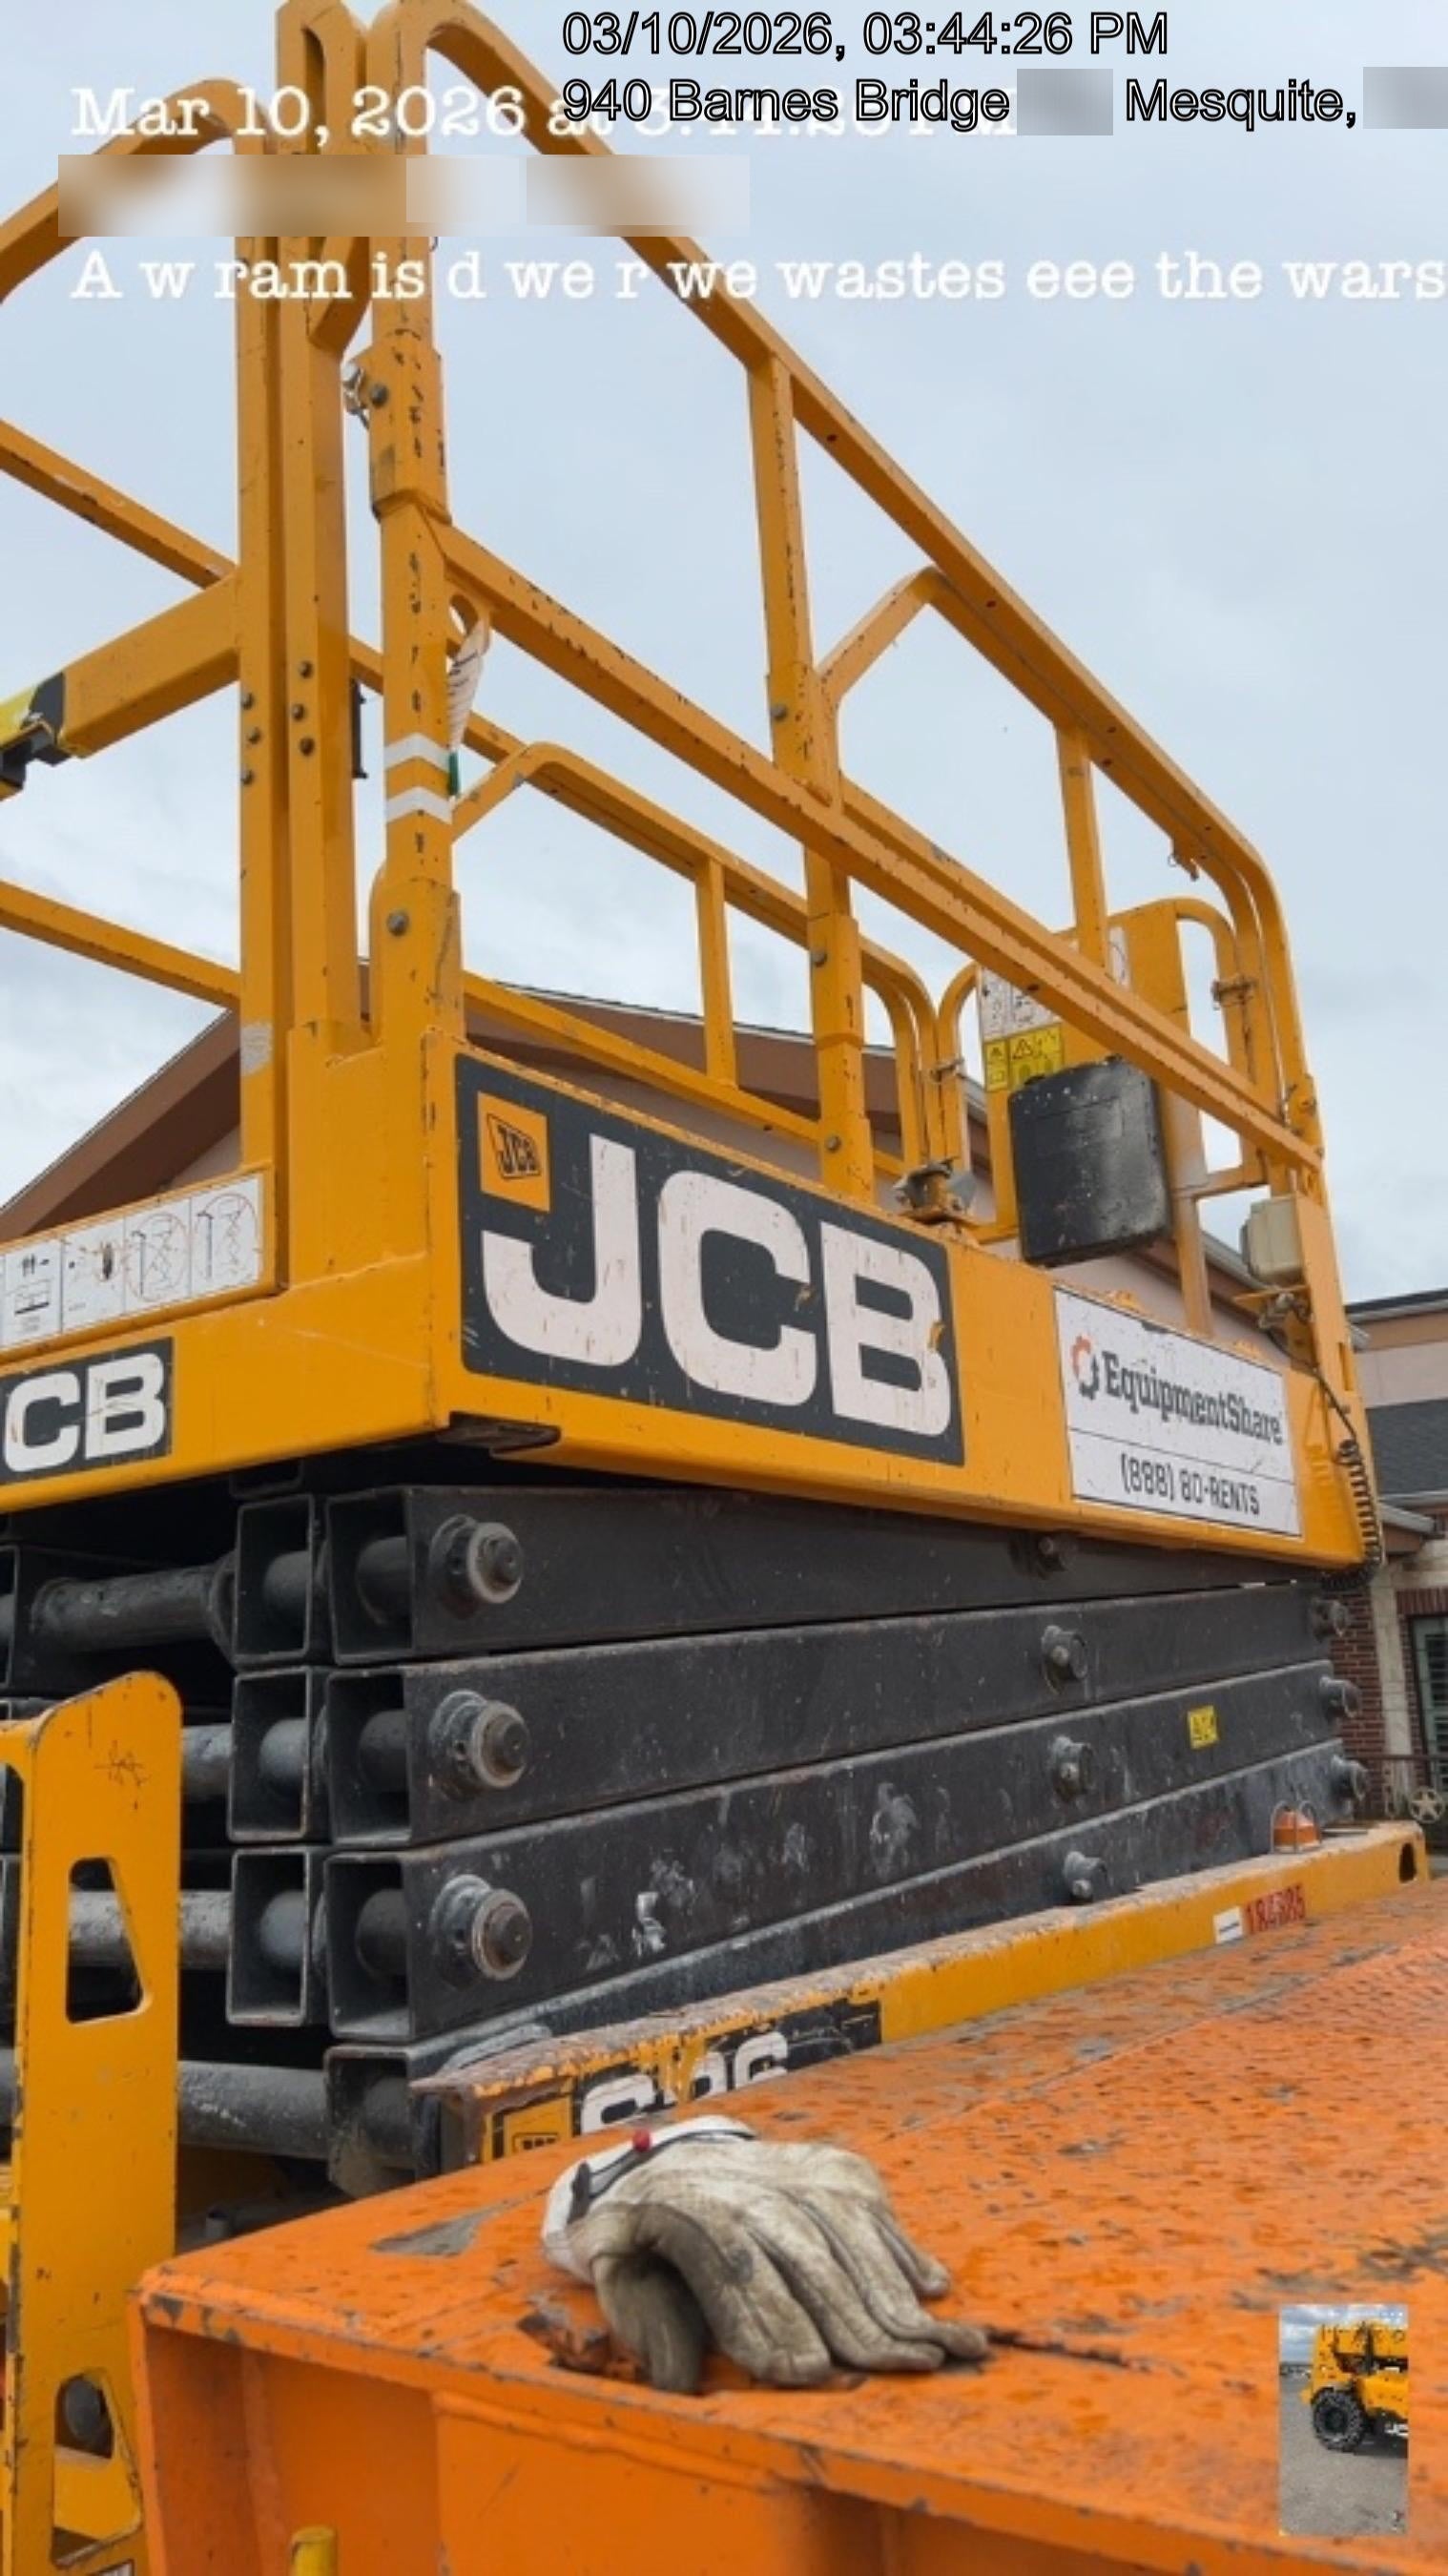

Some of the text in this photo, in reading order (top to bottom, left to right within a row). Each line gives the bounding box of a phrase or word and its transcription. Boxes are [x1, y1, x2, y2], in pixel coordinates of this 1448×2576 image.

[482, 1132, 951, 1436] JCB
[4, 1352, 167, 1473] CB
[1102, 1350, 1283, 1445] EquipmentShare
[1121, 1452, 1260, 1516] (888) 80-RENTS
